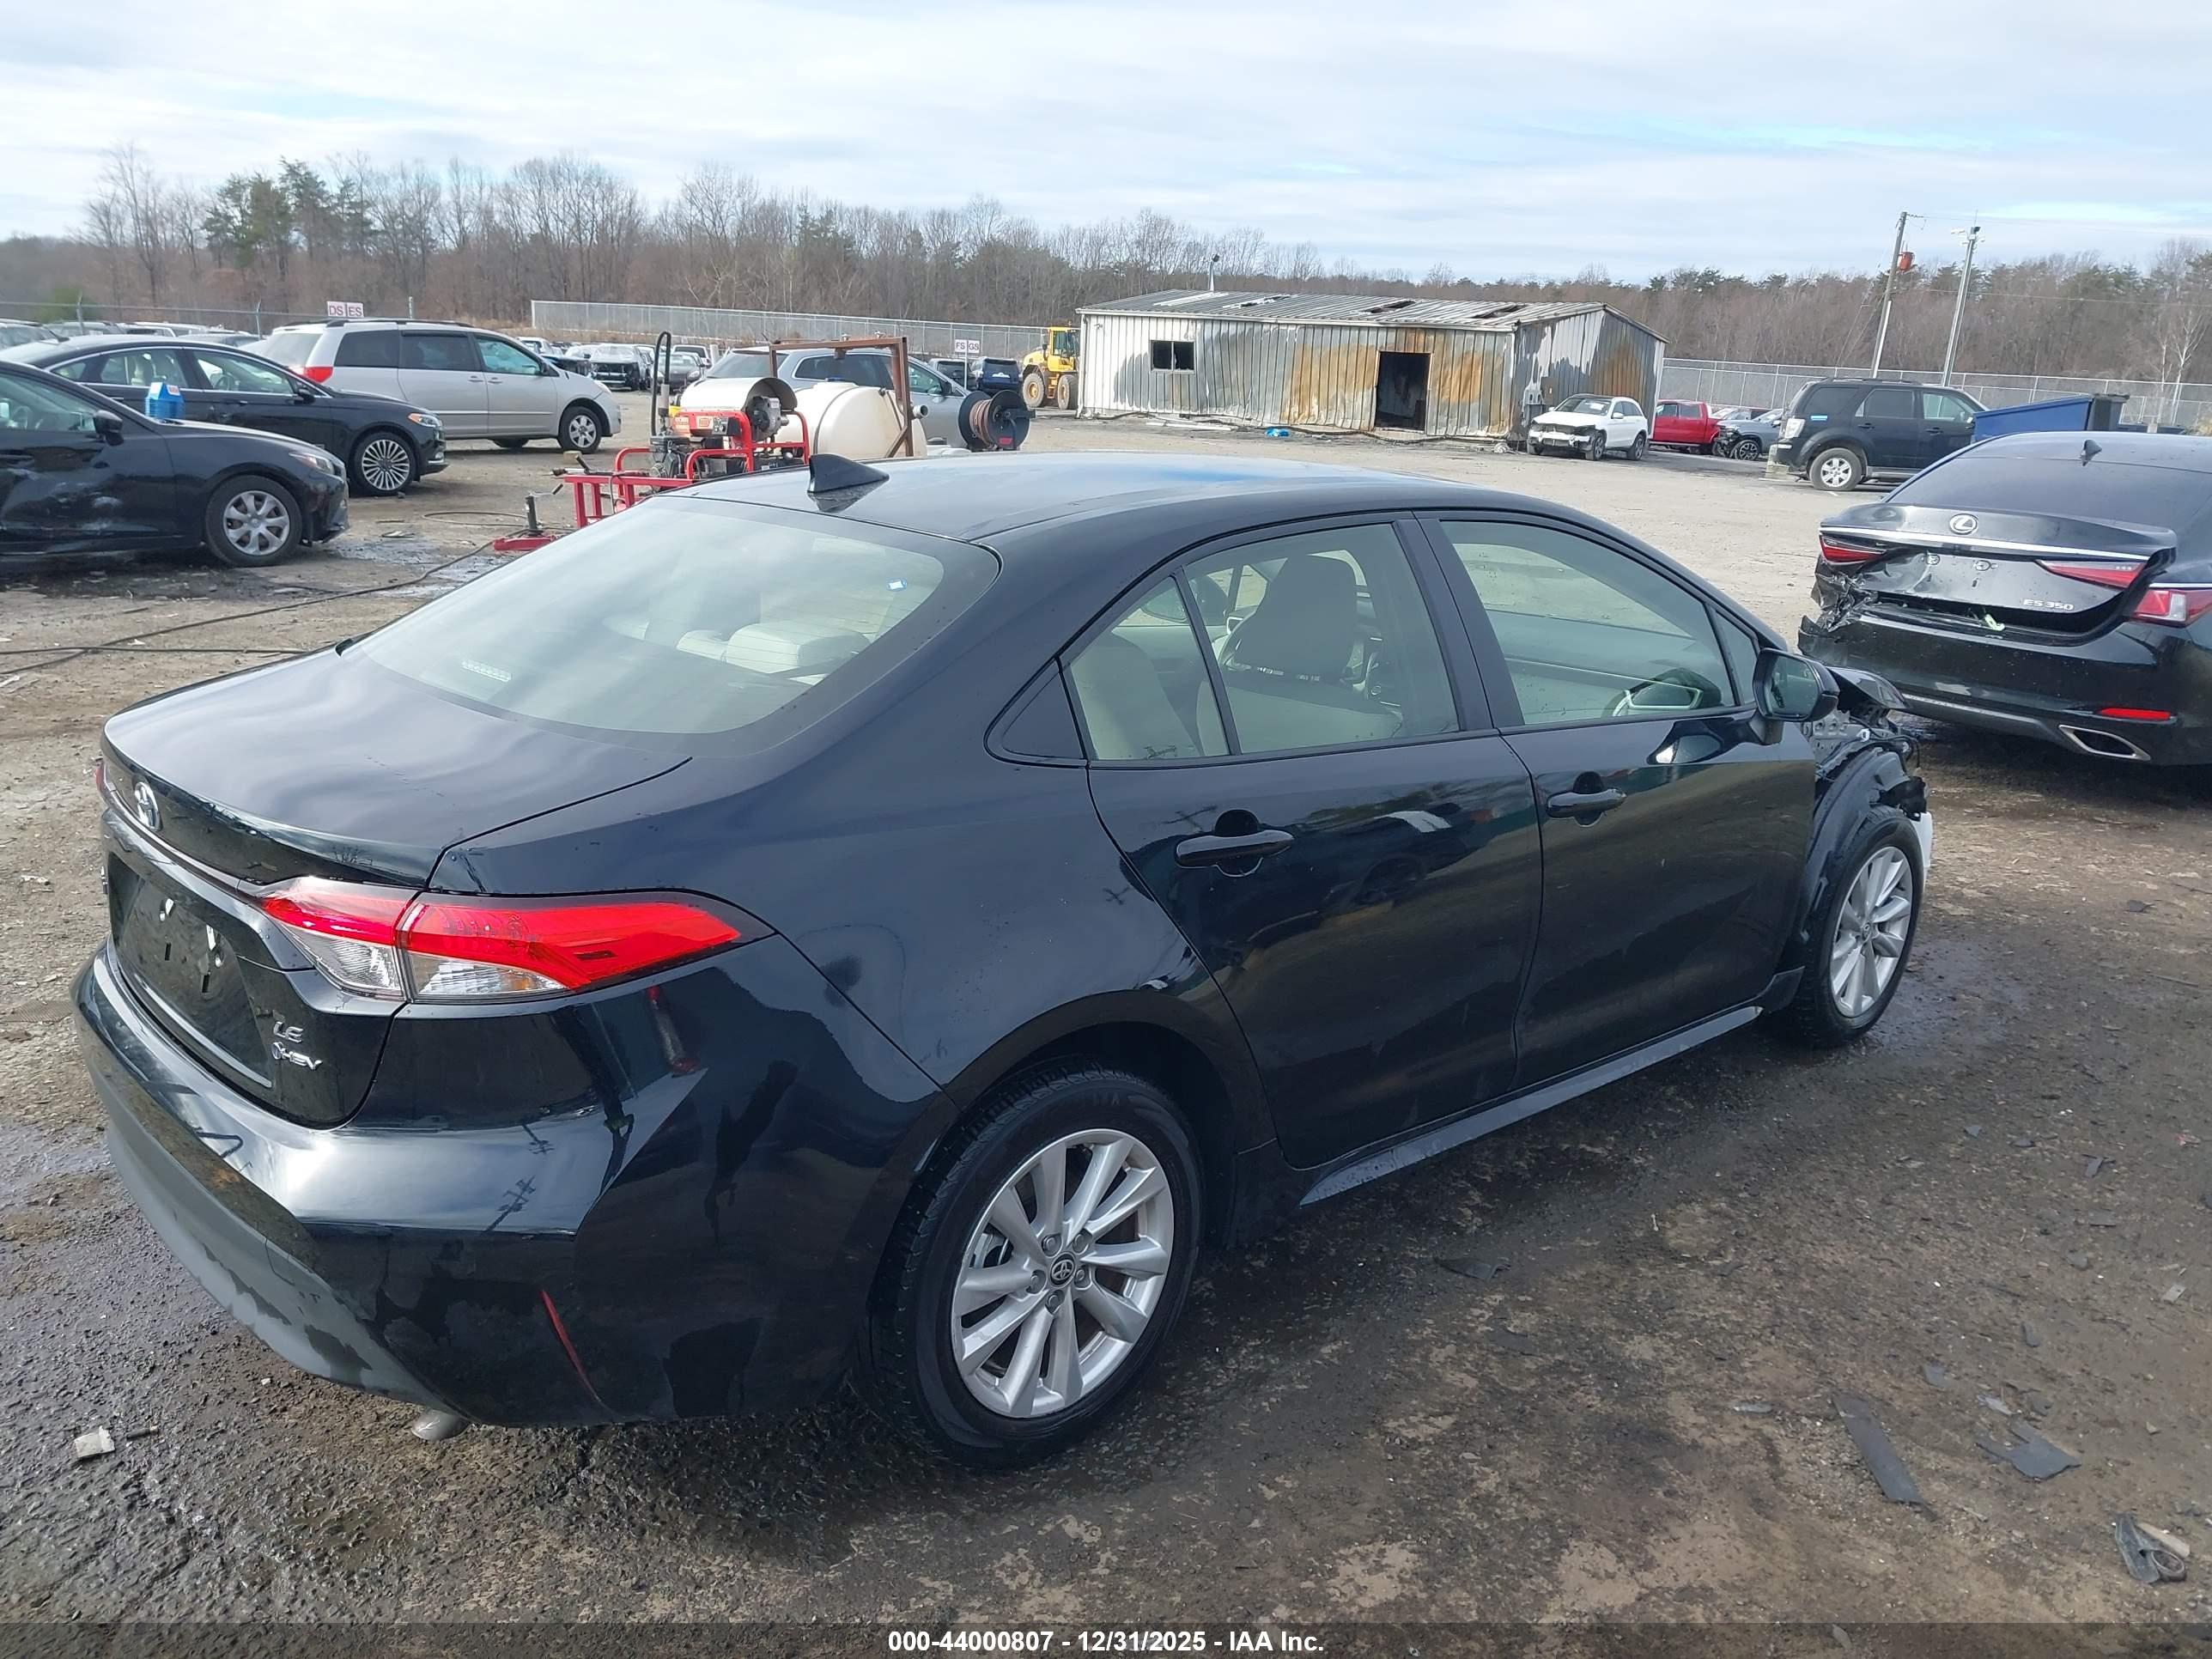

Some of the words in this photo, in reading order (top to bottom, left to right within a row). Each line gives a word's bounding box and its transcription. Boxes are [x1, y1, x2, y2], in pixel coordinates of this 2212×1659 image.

[329, 305, 343, 315] DS
[349, 307, 362, 317] ES
[2023, 599, 2044, 607] ES
[2045, 601, 2075, 611] 350
[273, 1021, 304, 1043] LE
